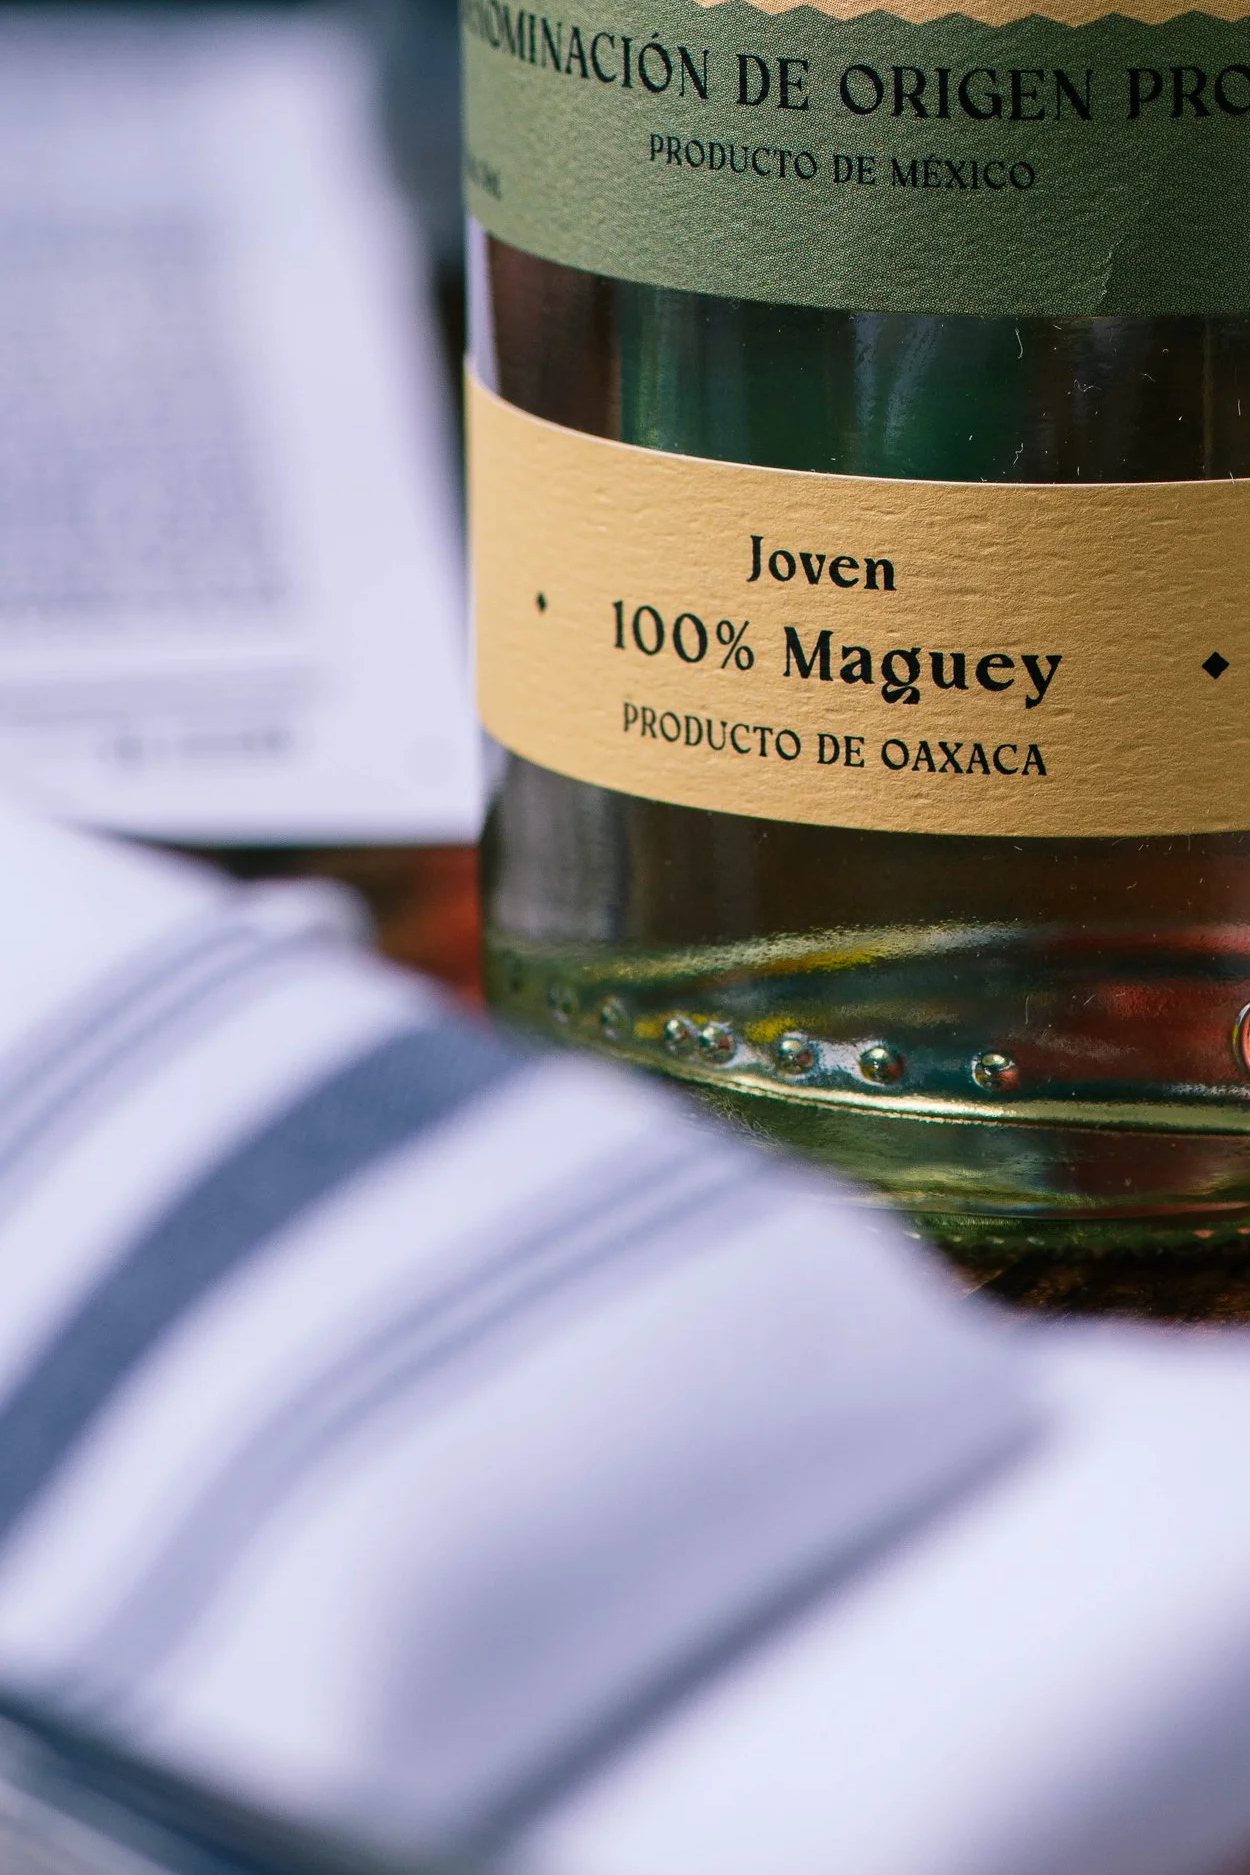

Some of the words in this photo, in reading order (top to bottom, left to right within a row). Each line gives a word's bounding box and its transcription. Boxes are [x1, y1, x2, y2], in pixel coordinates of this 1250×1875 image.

[735, 52, 810, 112] DE
[839, 63, 1094, 123] ORIGEN
[649, 133, 818, 181] PRODUCTO
[832, 153, 878, 186] DE
[745, 534, 898, 593] Joven
[612, 600, 756, 671] 100%
[782, 625, 1064, 710] Maguey
[622, 701, 802, 761] PRODUCTO
[817, 732, 867, 768] DE
[881, 738, 1049, 777] OAXACA
